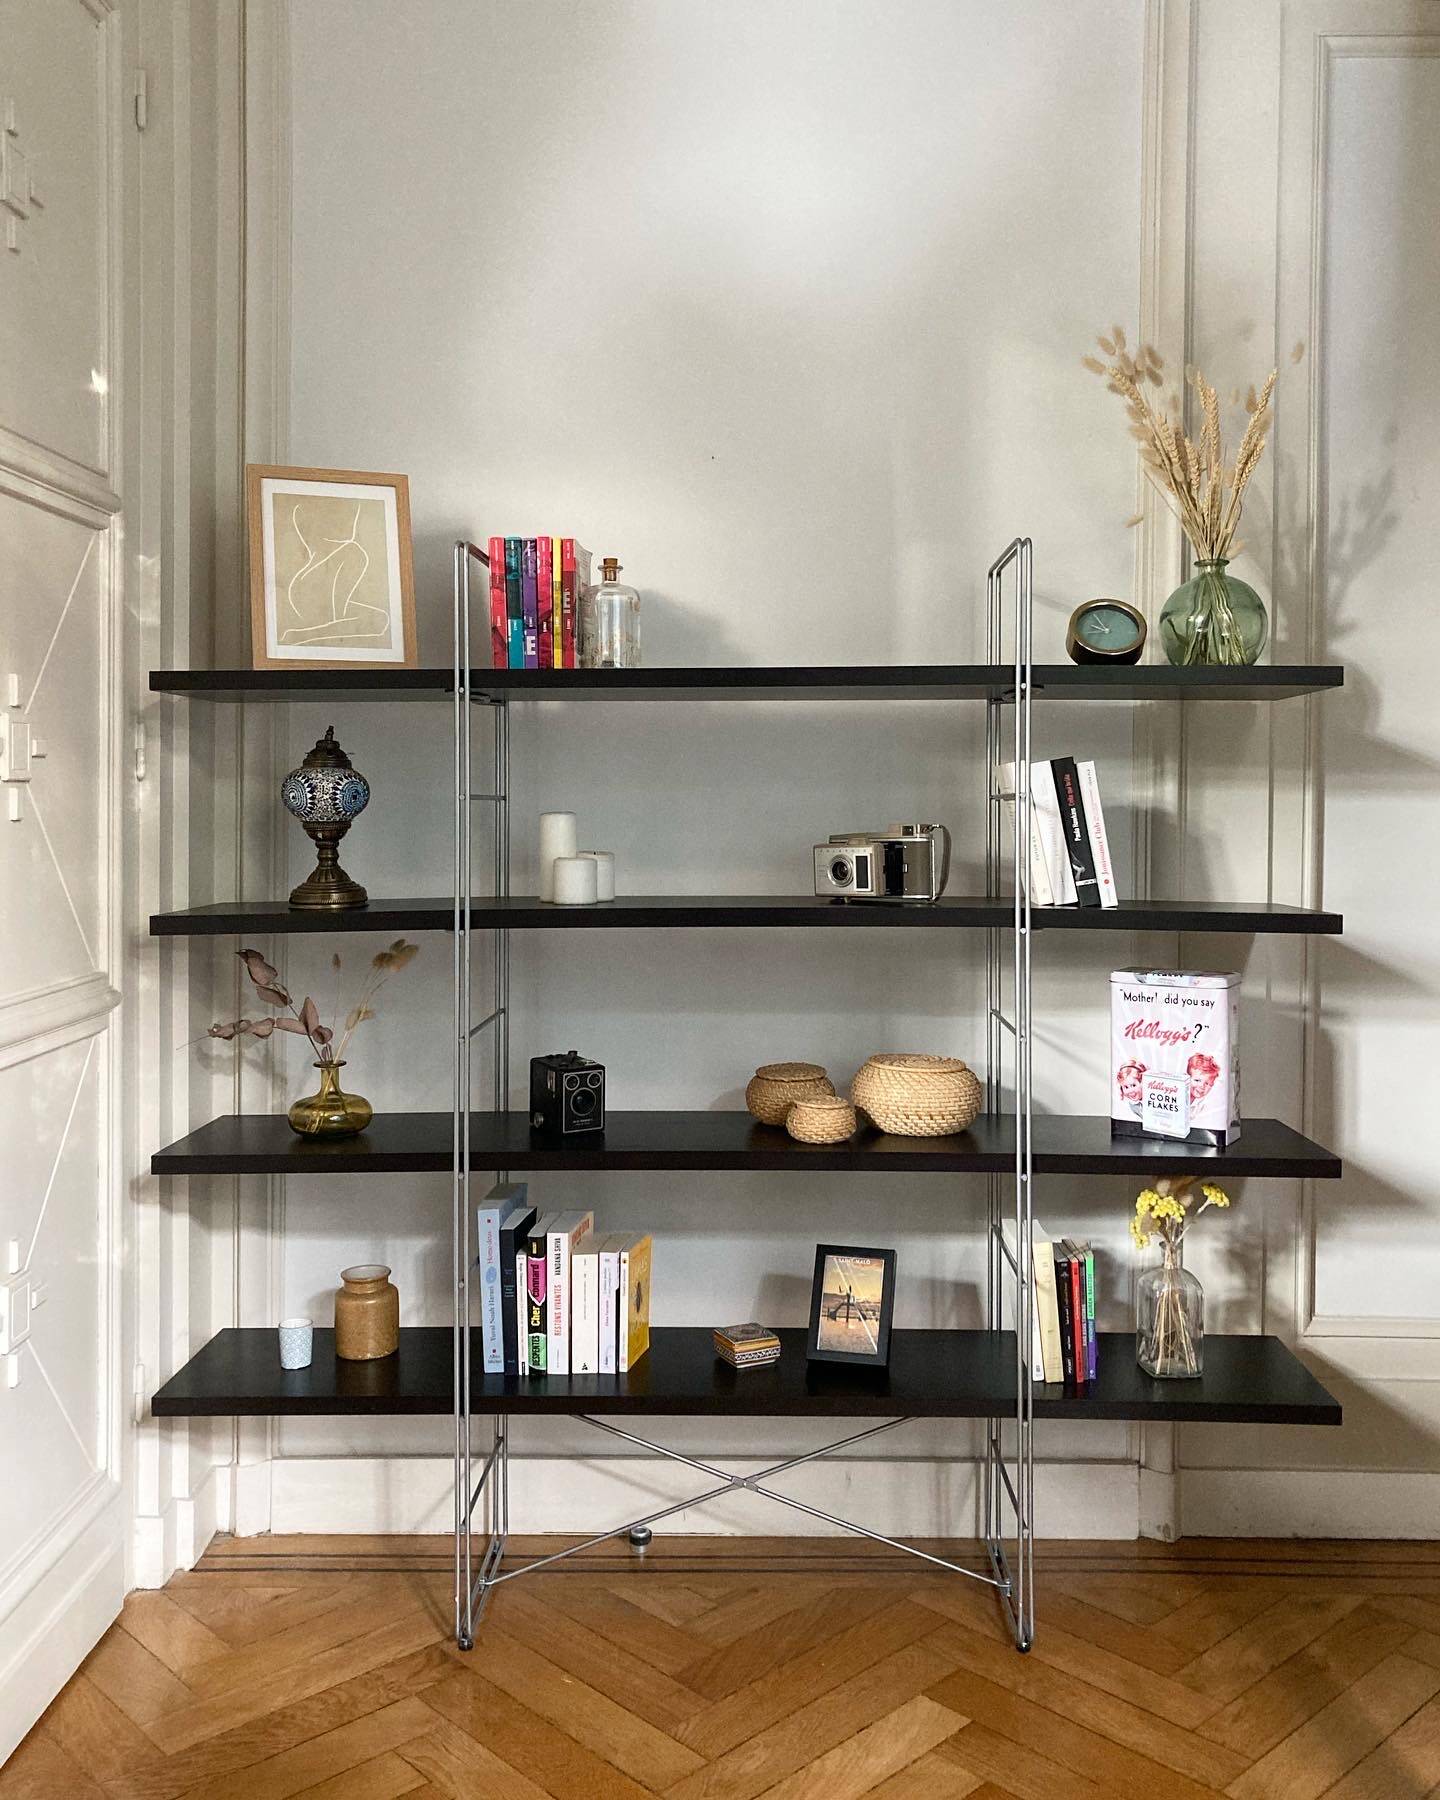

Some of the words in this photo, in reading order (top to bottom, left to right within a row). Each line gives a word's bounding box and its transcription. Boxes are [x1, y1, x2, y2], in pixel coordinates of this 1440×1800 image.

[1164, 993, 1178, 1004] did
[1181, 997, 1198, 1007] you
[1200, 998, 1215, 1008] say
[1147, 1100, 1179, 1112] FLAKES
[1149, 1092, 1178, 1104] CORN
[531, 1263, 540, 1297] connard
[531, 1305, 541, 1326] Cher
[531, 1335, 540, 1366] DESPENTES
